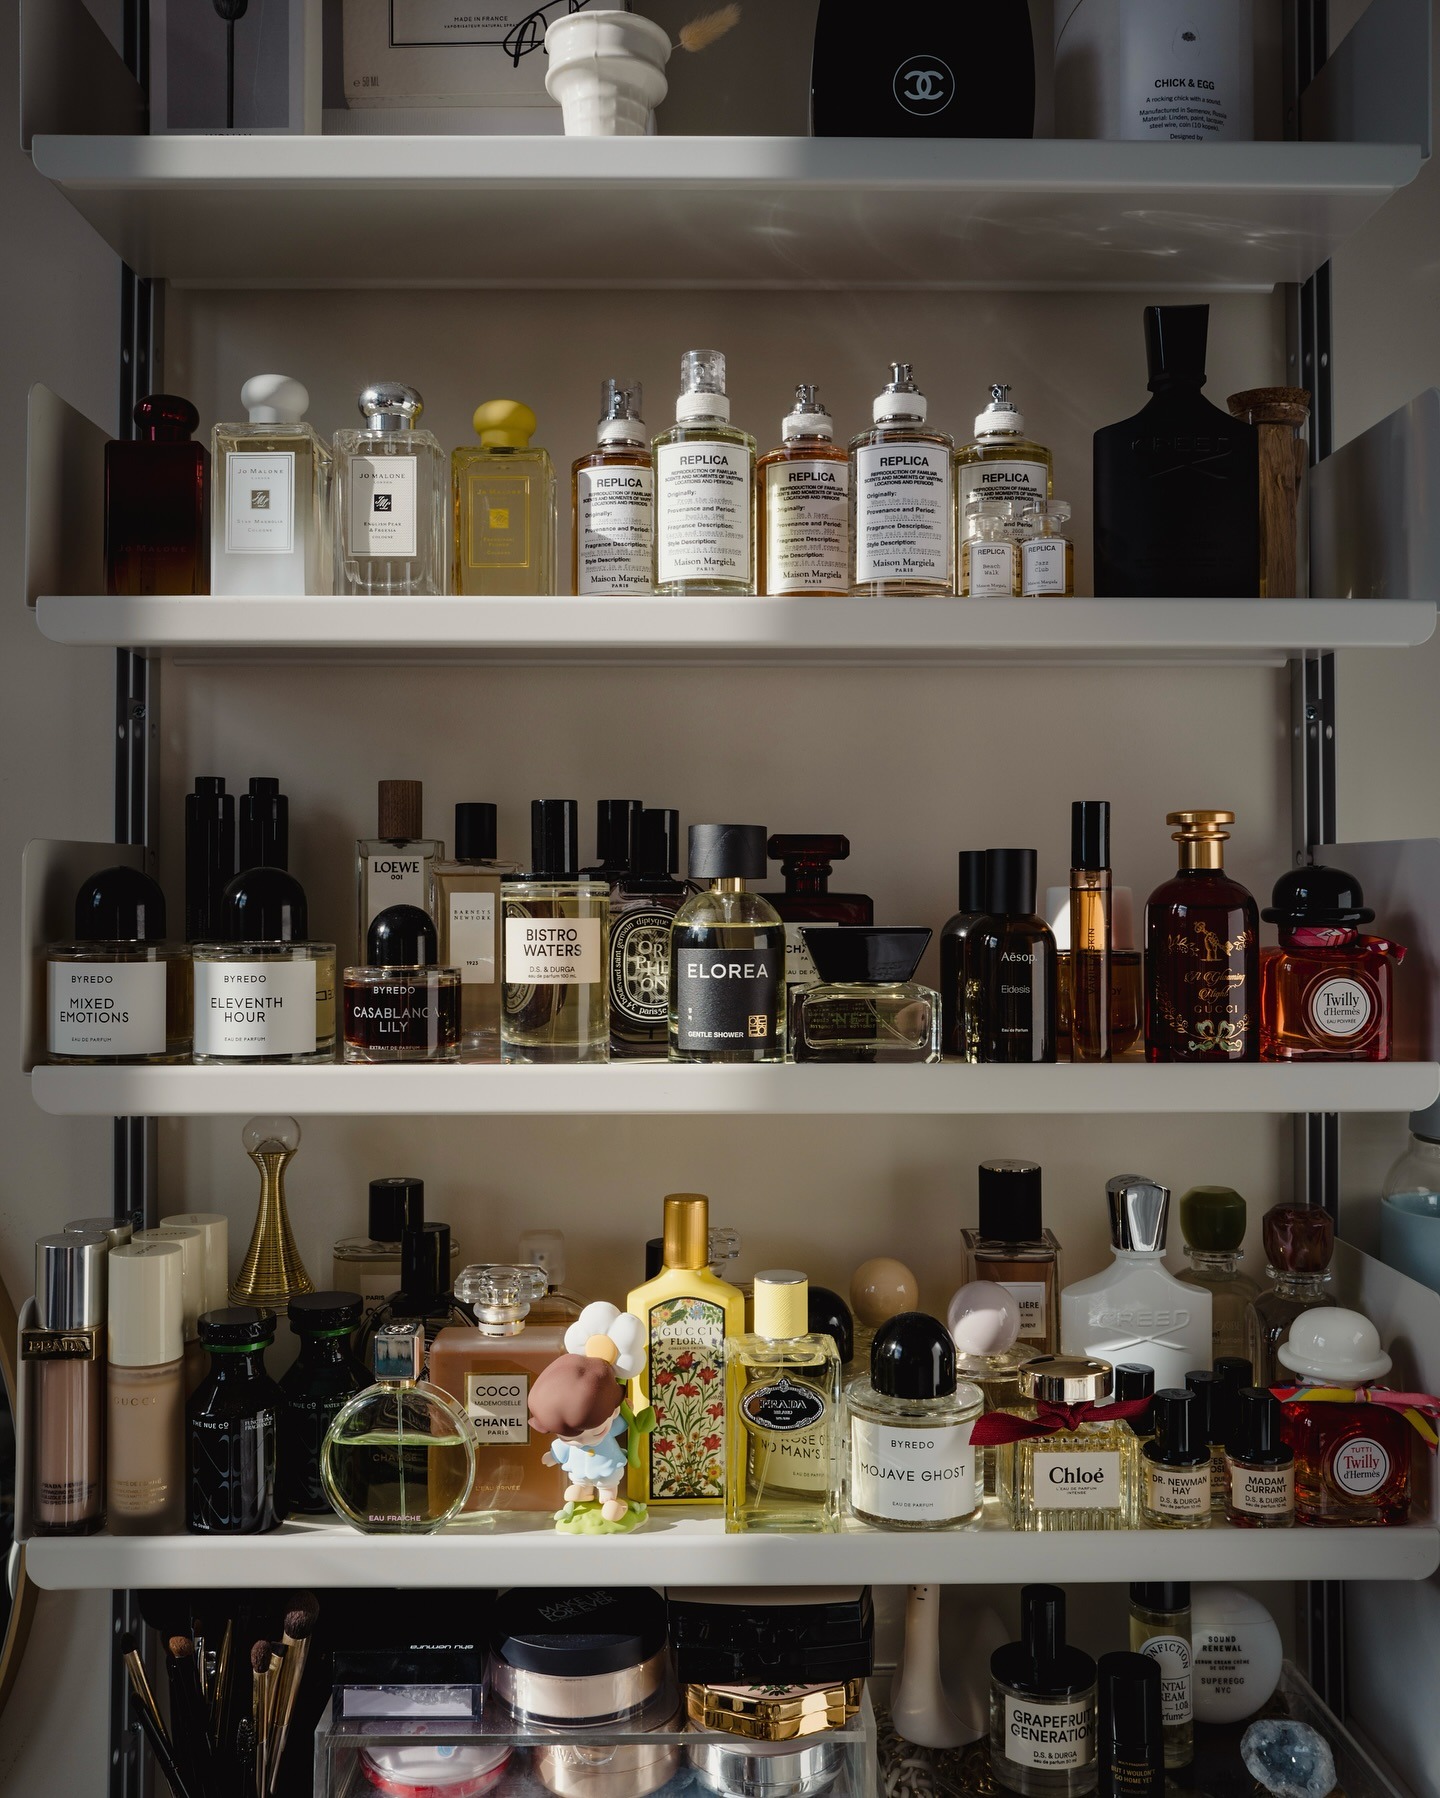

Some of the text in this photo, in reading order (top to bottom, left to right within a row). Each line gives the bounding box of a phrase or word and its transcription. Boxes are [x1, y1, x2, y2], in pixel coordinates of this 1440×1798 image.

[362, 76, 380, 87] 50 ML
[1154, 78, 1215, 90] CHICK & EGG
[1206, 98, 1221, 106] sound.
[1140, 107, 1179, 116] Manufactured
[680, 456, 728, 466] REPLICA
[880, 456, 929, 466] REPLICA
[789, 472, 835, 482] REPLICA
[983, 474, 1029, 483] REPLICA
[597, 478, 643, 488] REPLICA
[137, 544, 187, 553] MALONE
[873, 558, 935, 568] Maison Margiela
[591, 575, 649, 584] Maison Margiela
[783, 570, 842, 579] Maison Margiela
[374, 862, 420, 873] LOEWE
[636, 918, 669, 926] diptyque
[526, 928, 577, 941] BISTRO
[617, 922, 634, 949] germain
[523, 944, 582, 957] WATERS
[638, 940, 664, 958] OR
[687, 963, 769, 979] ELOREA
[71, 975, 113, 984] BYREDO
[224, 975, 267, 983] BYREDO
[373, 986, 415, 995] BYREDO
[615, 970, 627, 1006] boulevard
[1001, 985, 1030, 994] Eidesis
[70, 998, 114, 1009] MIXED
[211, 997, 283, 1008] ELEVENTH
[1324, 992, 1360, 1008] Twilly
[354, 1006, 440, 1019] CASABLANCA
[1194, 1004, 1238, 1014] GUCCI
[60, 1011, 129, 1023] EMOTIONS
[224, 1012, 266, 1023] HOUR
[379, 1021, 408, 1032] LILY
[1098, 1309, 1192, 1328] CREED
[662, 1327, 712, 1336] GUCCI
[29, 1338, 90, 1352] PRADA
[670, 1337, 704, 1345] FLORA
[476, 1386, 520, 1397] COCO
[760, 1400, 807, 1408] PRADA
[474, 1418, 522, 1427] CHANEL
[891, 1440, 934, 1449] BYREDO
[781, 1445, 820, 1460] MAN'S
[1344, 1455, 1380, 1469] Twilly
[861, 1462, 965, 1482] MOJAVE GHOST
[1049, 1466, 1104, 1484] Chloé
[1152, 1474, 1165, 1484] DR.
[1168, 1476, 1207, 1486] NEWMAN
[1248, 1476, 1284, 1485] MADAM
[1172, 1487, 1191, 1495] HAY
[1245, 1485, 1287, 1494] CURRANT
[538, 1591, 608, 1615] MAKE UP
[545, 1607, 578, 1622] FOR
[578, 1597, 617, 1612] EVER
[1147, 1643, 1189, 1669] ONFICTION
[1013, 1708, 1091, 1728] GRAPEFRUIT
[1011, 1723, 1093, 1743] GENERATION
[1111, 1764, 1121, 1773] BUT
